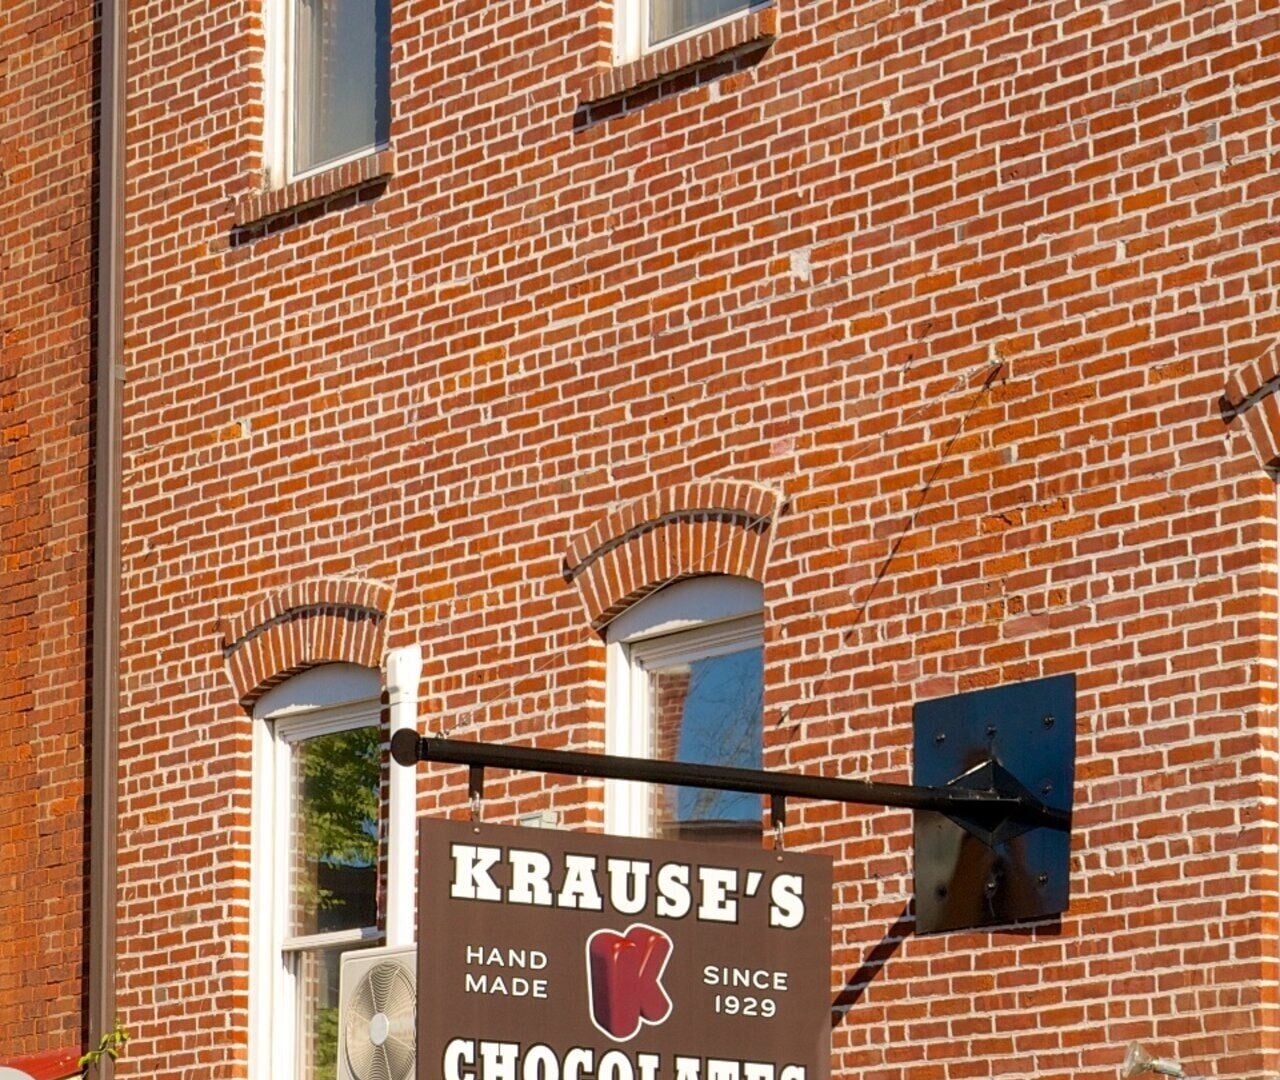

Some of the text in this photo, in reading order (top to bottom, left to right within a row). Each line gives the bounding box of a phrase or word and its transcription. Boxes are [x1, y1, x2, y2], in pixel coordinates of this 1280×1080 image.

[449, 843, 806, 929] KRAUSE'S
[466, 945, 548, 970] HAND
[464, 973, 548, 999] MADE
[703, 966, 789, 991] SINCE
[714, 995, 777, 1018] 1929
